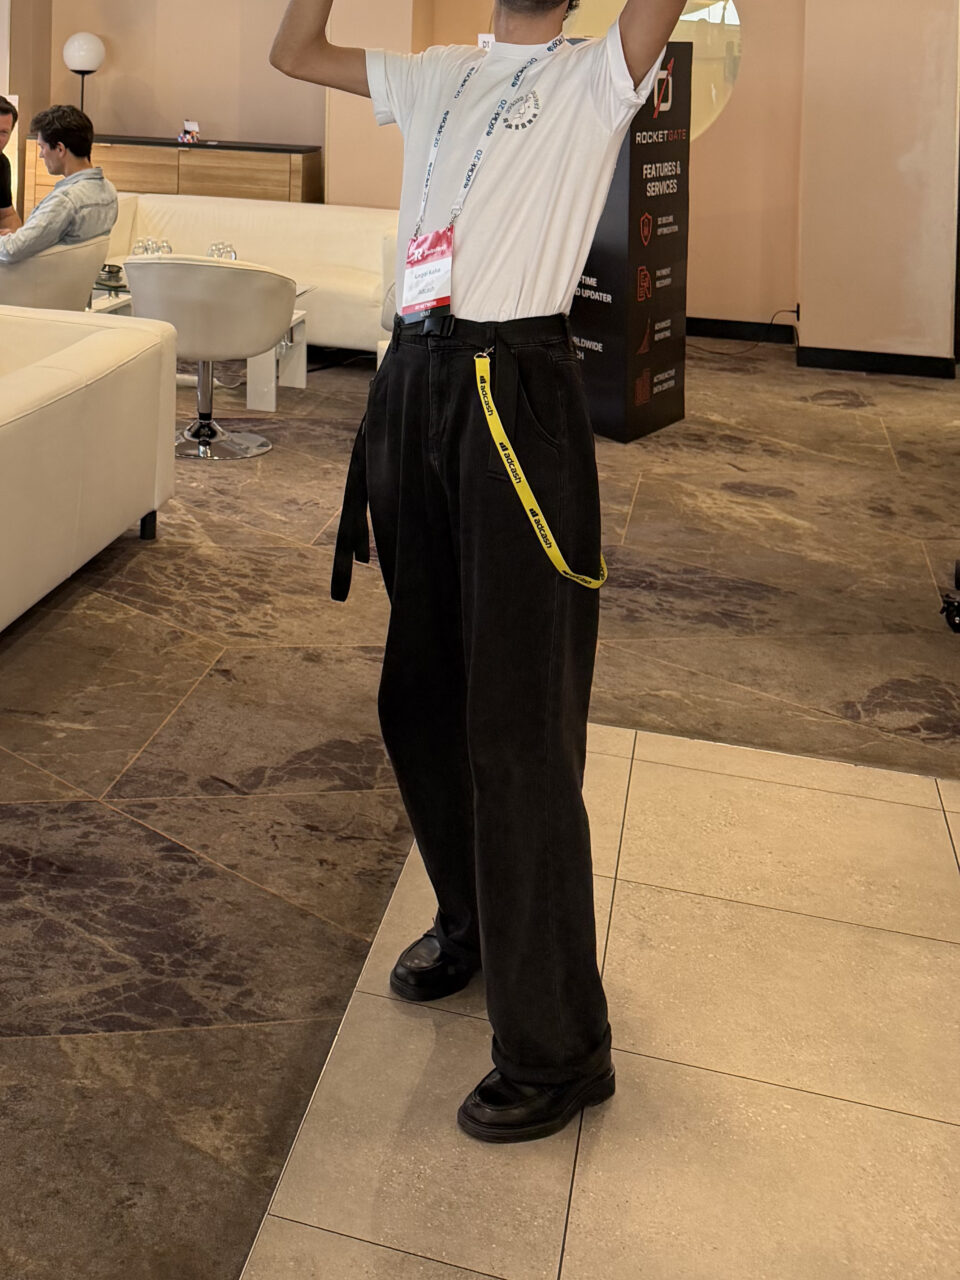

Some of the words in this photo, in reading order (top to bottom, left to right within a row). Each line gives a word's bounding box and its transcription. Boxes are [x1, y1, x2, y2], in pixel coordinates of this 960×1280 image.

[497, 99, 508, 111] 20
[636, 129, 687, 144] ROCKETGATE
[473, 149, 483, 161] 20
[642, 162, 676, 179] FEATURES
[676, 161, 681, 174] &
[646, 179, 678, 197] SERVICES
[581, 289, 612, 303] UPDATER
[480, 384, 494, 417] adcash
[504, 452, 521, 485] adcash
[534, 518, 552, 549] adcash
